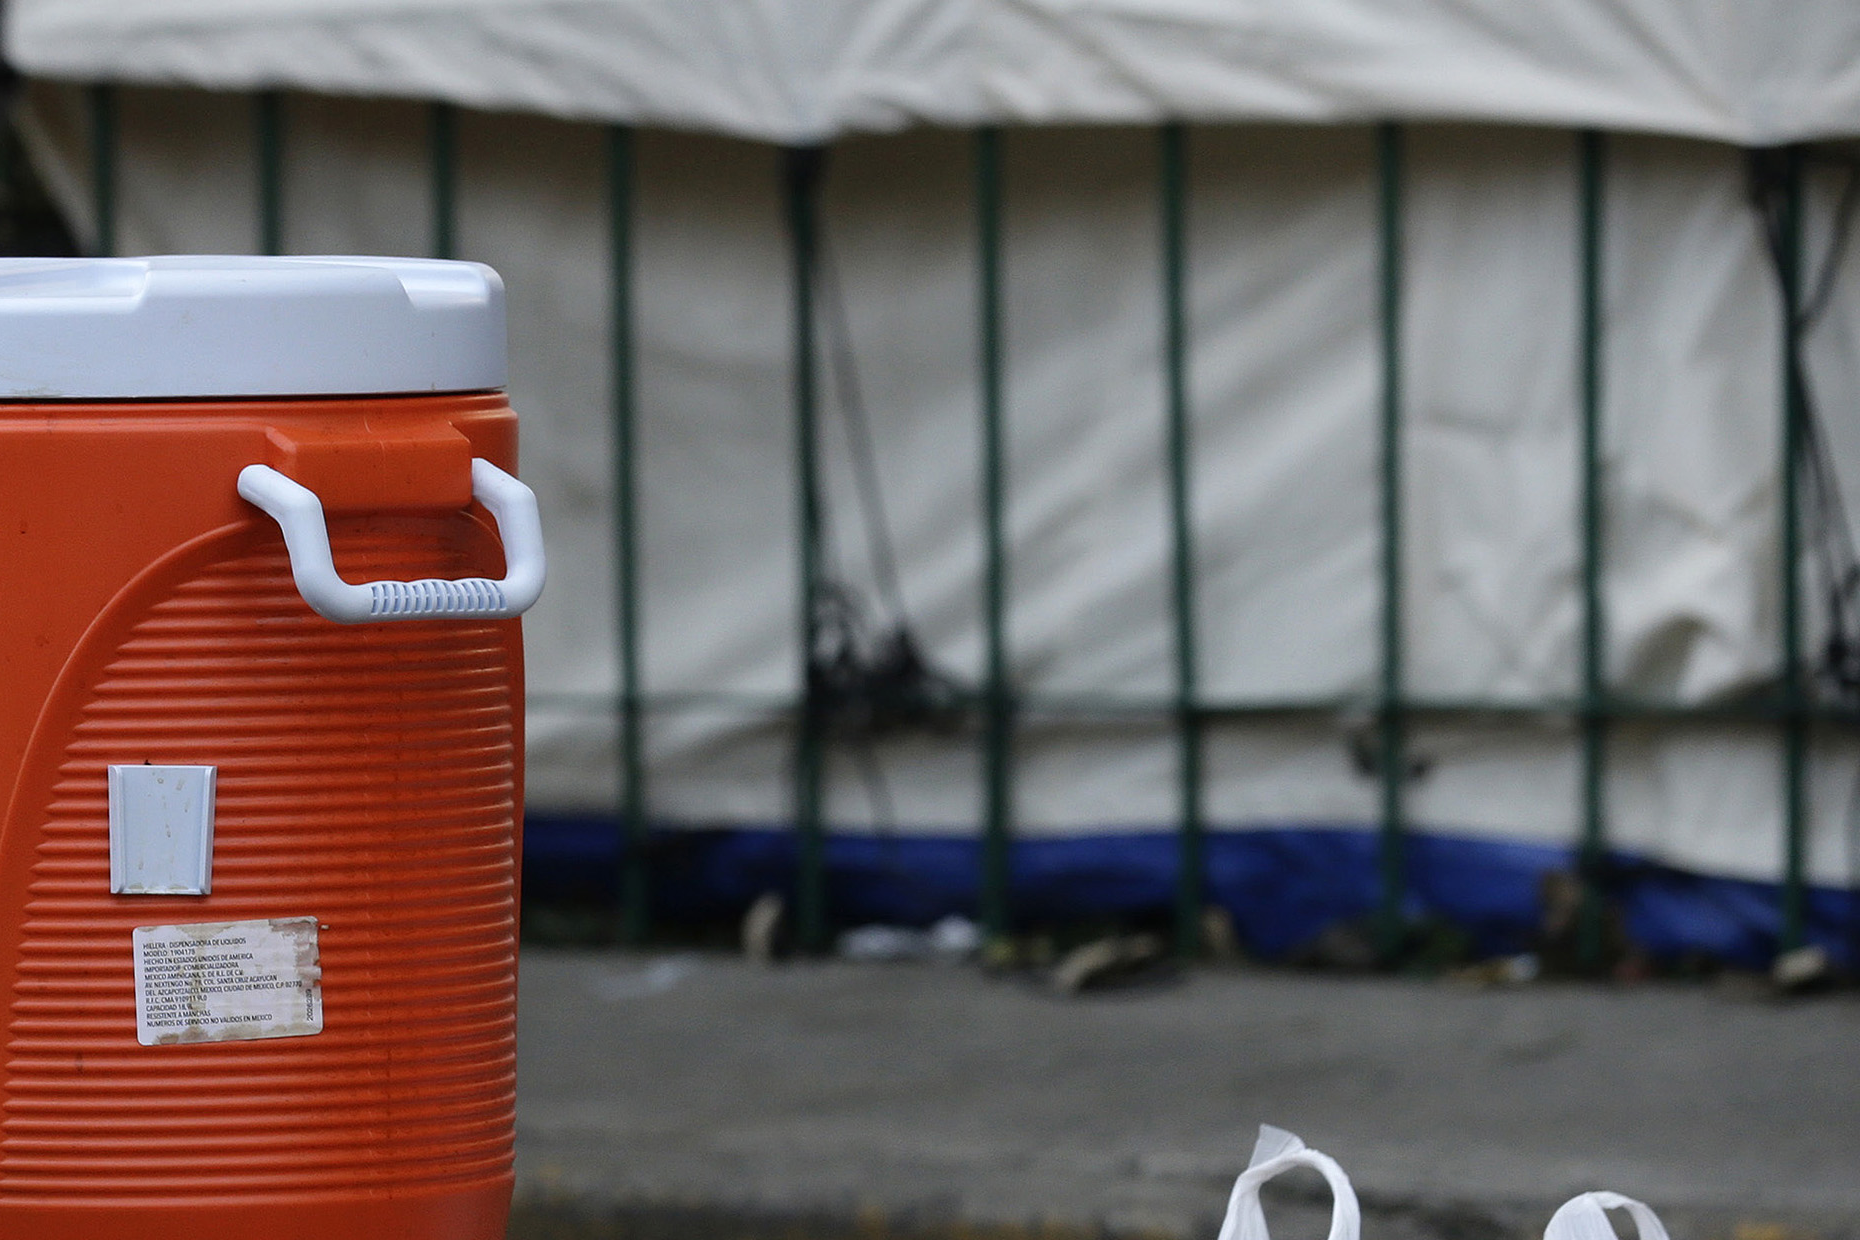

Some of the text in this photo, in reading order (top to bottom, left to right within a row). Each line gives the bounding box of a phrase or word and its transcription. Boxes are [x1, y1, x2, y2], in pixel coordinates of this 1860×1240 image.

[174, 956, 197, 964] ESTADOS
[217, 977, 234, 985] SANTA
[146, 1004, 177, 1012] CAPACIDAD
[146, 1012, 177, 1020] RESISTENTE
[184, 1018, 209, 1026] SERVICIO
